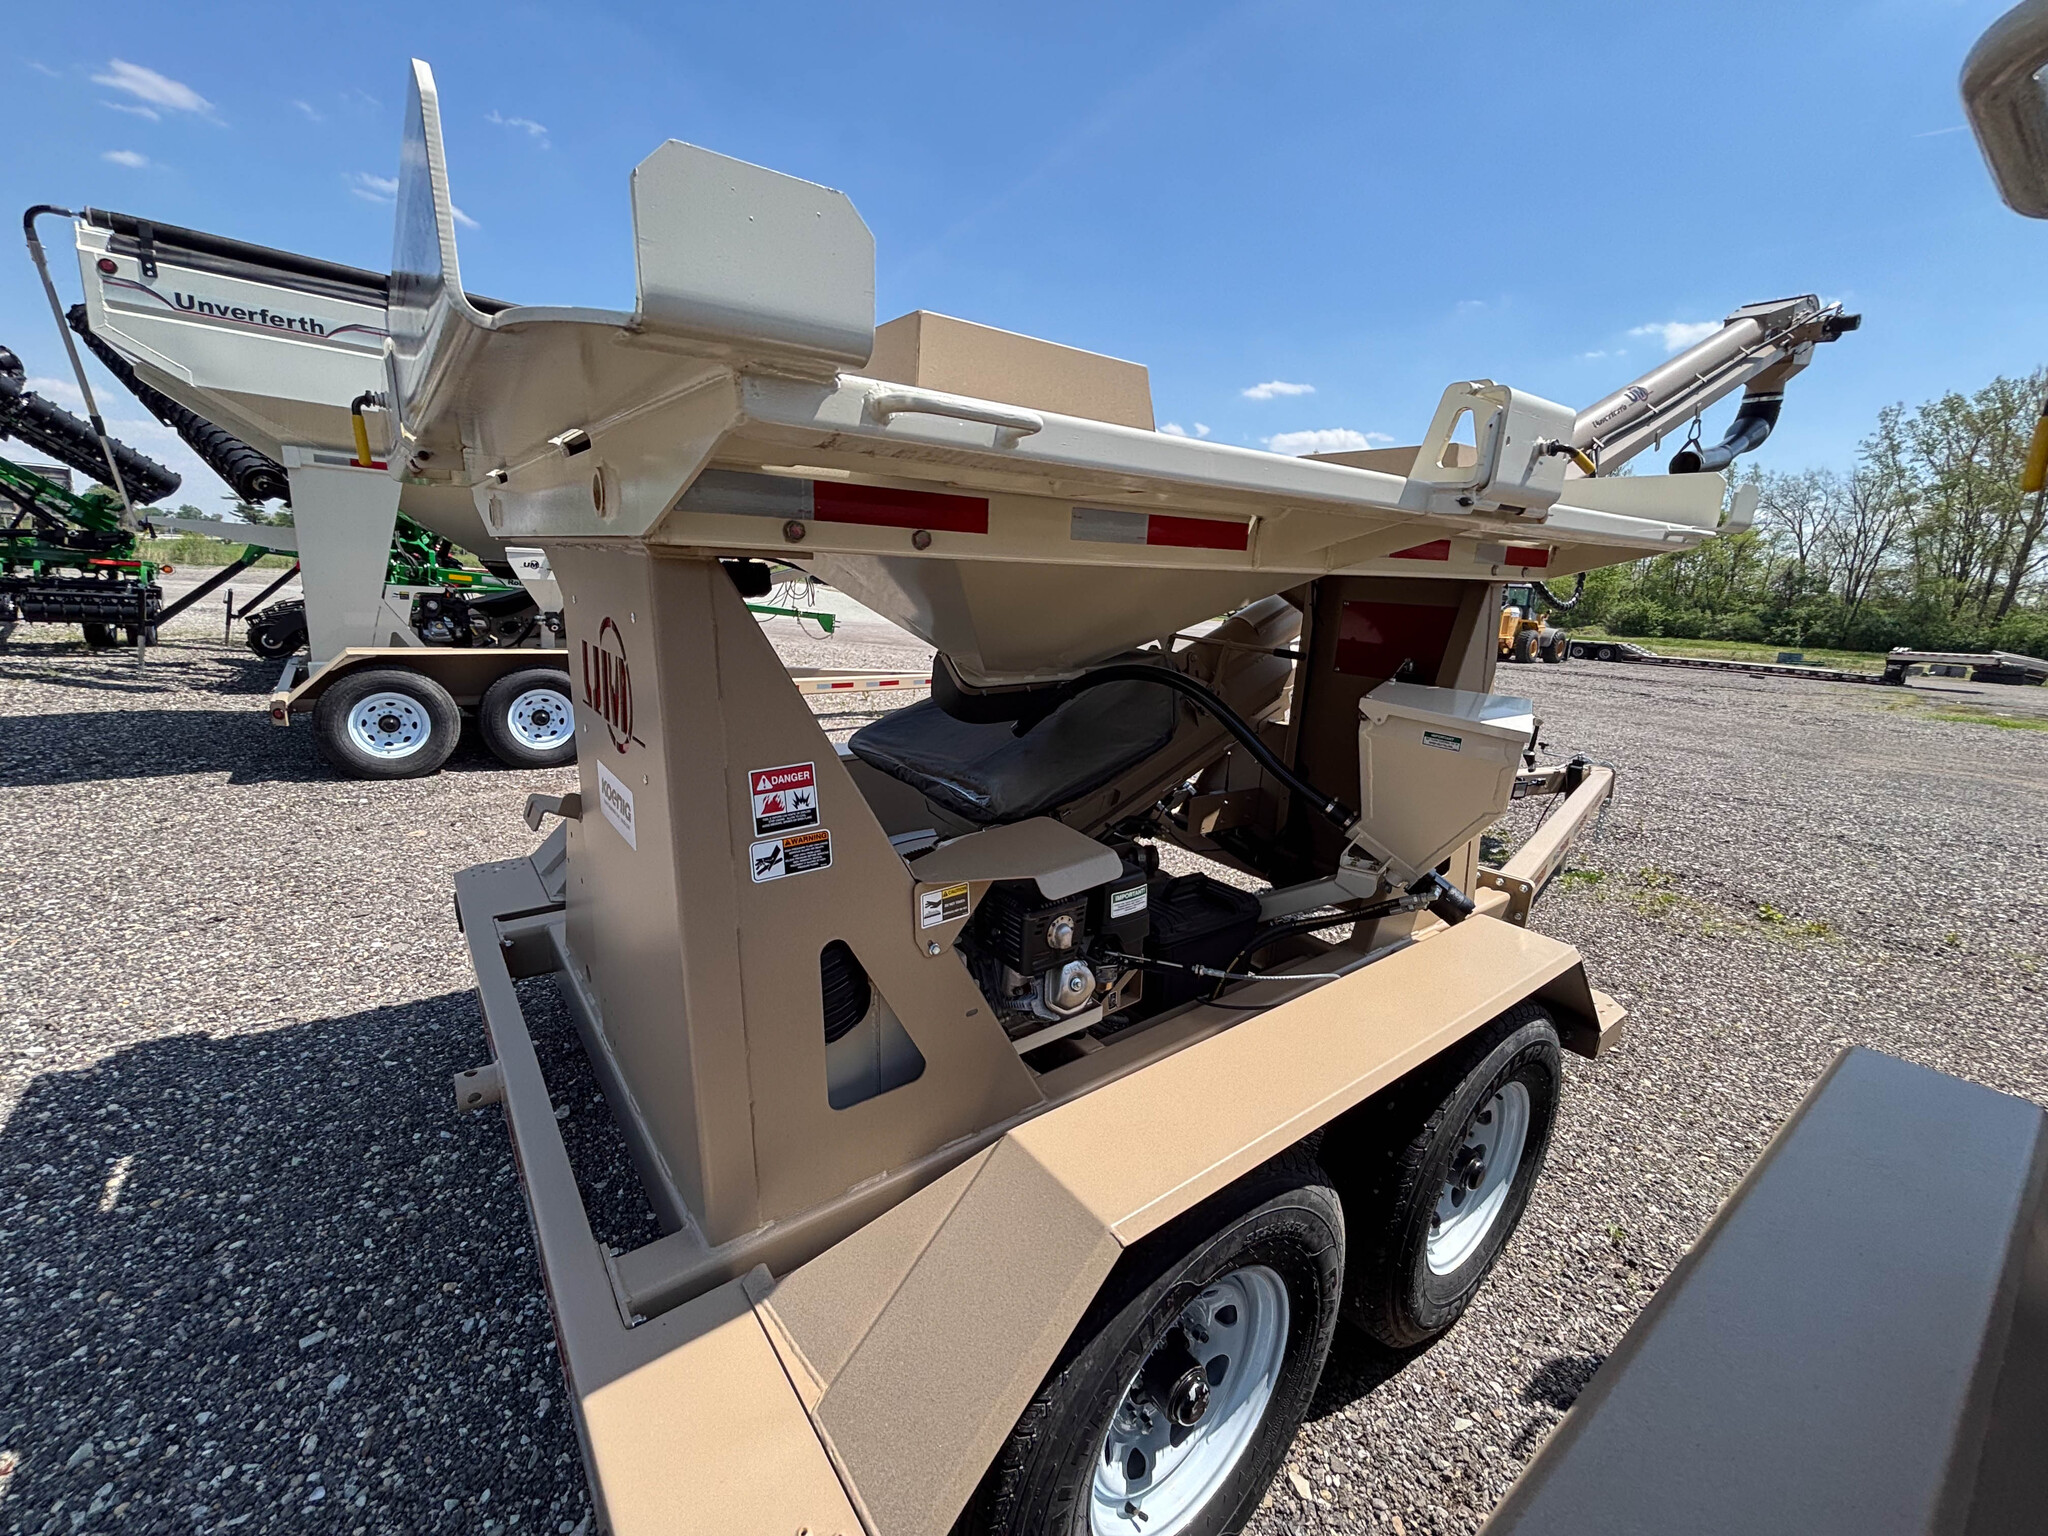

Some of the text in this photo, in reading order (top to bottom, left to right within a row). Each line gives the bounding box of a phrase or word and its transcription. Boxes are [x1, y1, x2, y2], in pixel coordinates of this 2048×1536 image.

[173, 292, 325, 335] Unverferth
[522, 560, 540, 570] UM
[582, 630, 631, 744] UM
[771, 771, 811, 785] DANGER
[791, 832, 828, 845] WARNING
